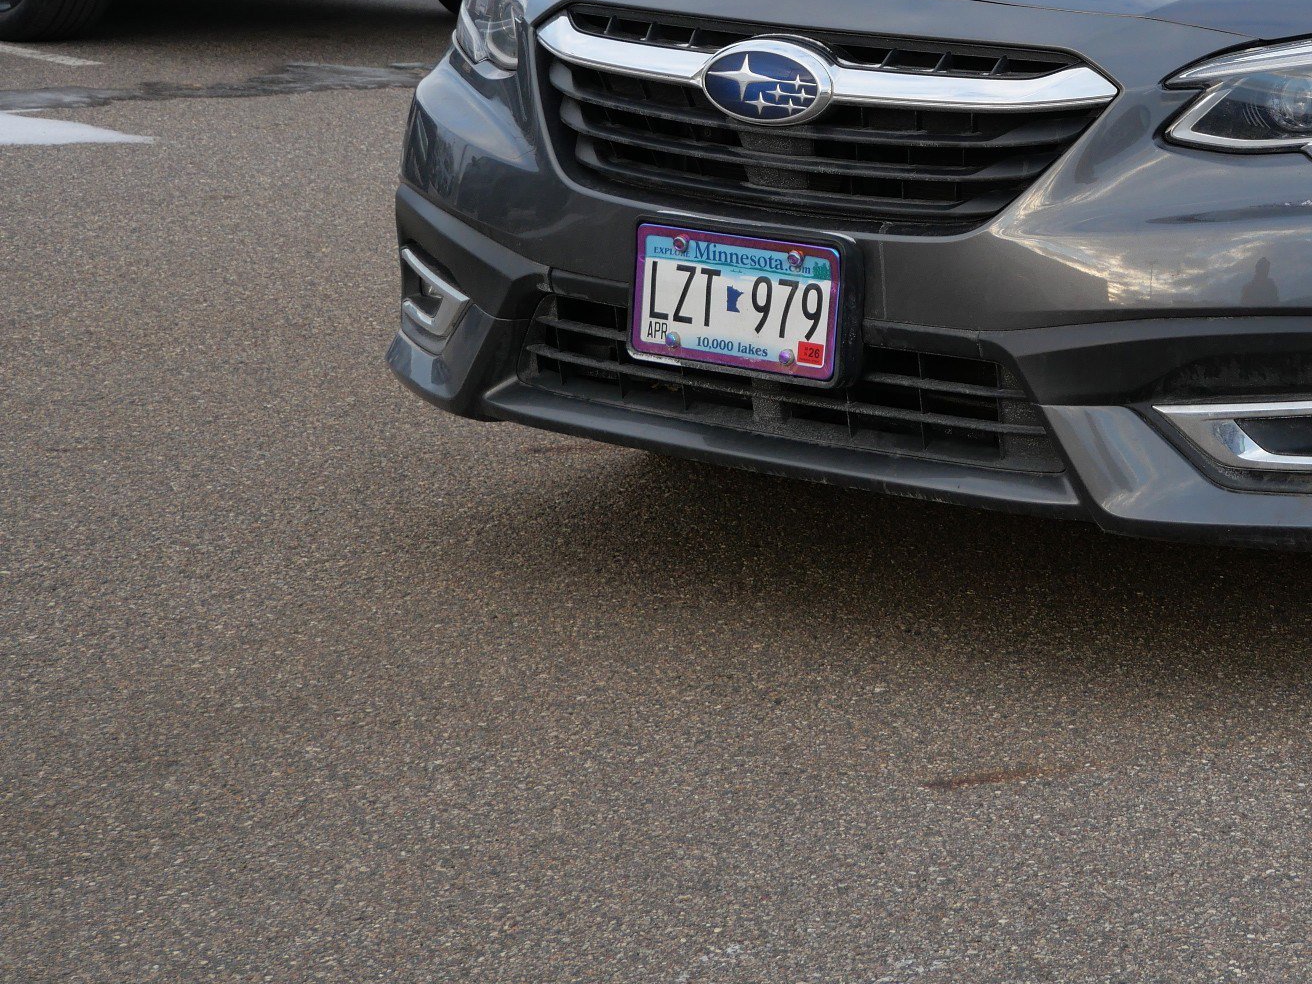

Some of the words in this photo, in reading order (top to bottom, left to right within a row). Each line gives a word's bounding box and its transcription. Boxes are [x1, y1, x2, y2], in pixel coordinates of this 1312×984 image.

[653, 246, 690, 257] EXPLOE
[649, 260, 721, 327] LZT
[752, 276, 824, 341] 979
[647, 321, 668, 339] APR
[697, 336, 734, 352] 10,000
[738, 342, 768, 357] lakes
[808, 347, 820, 359] 26
